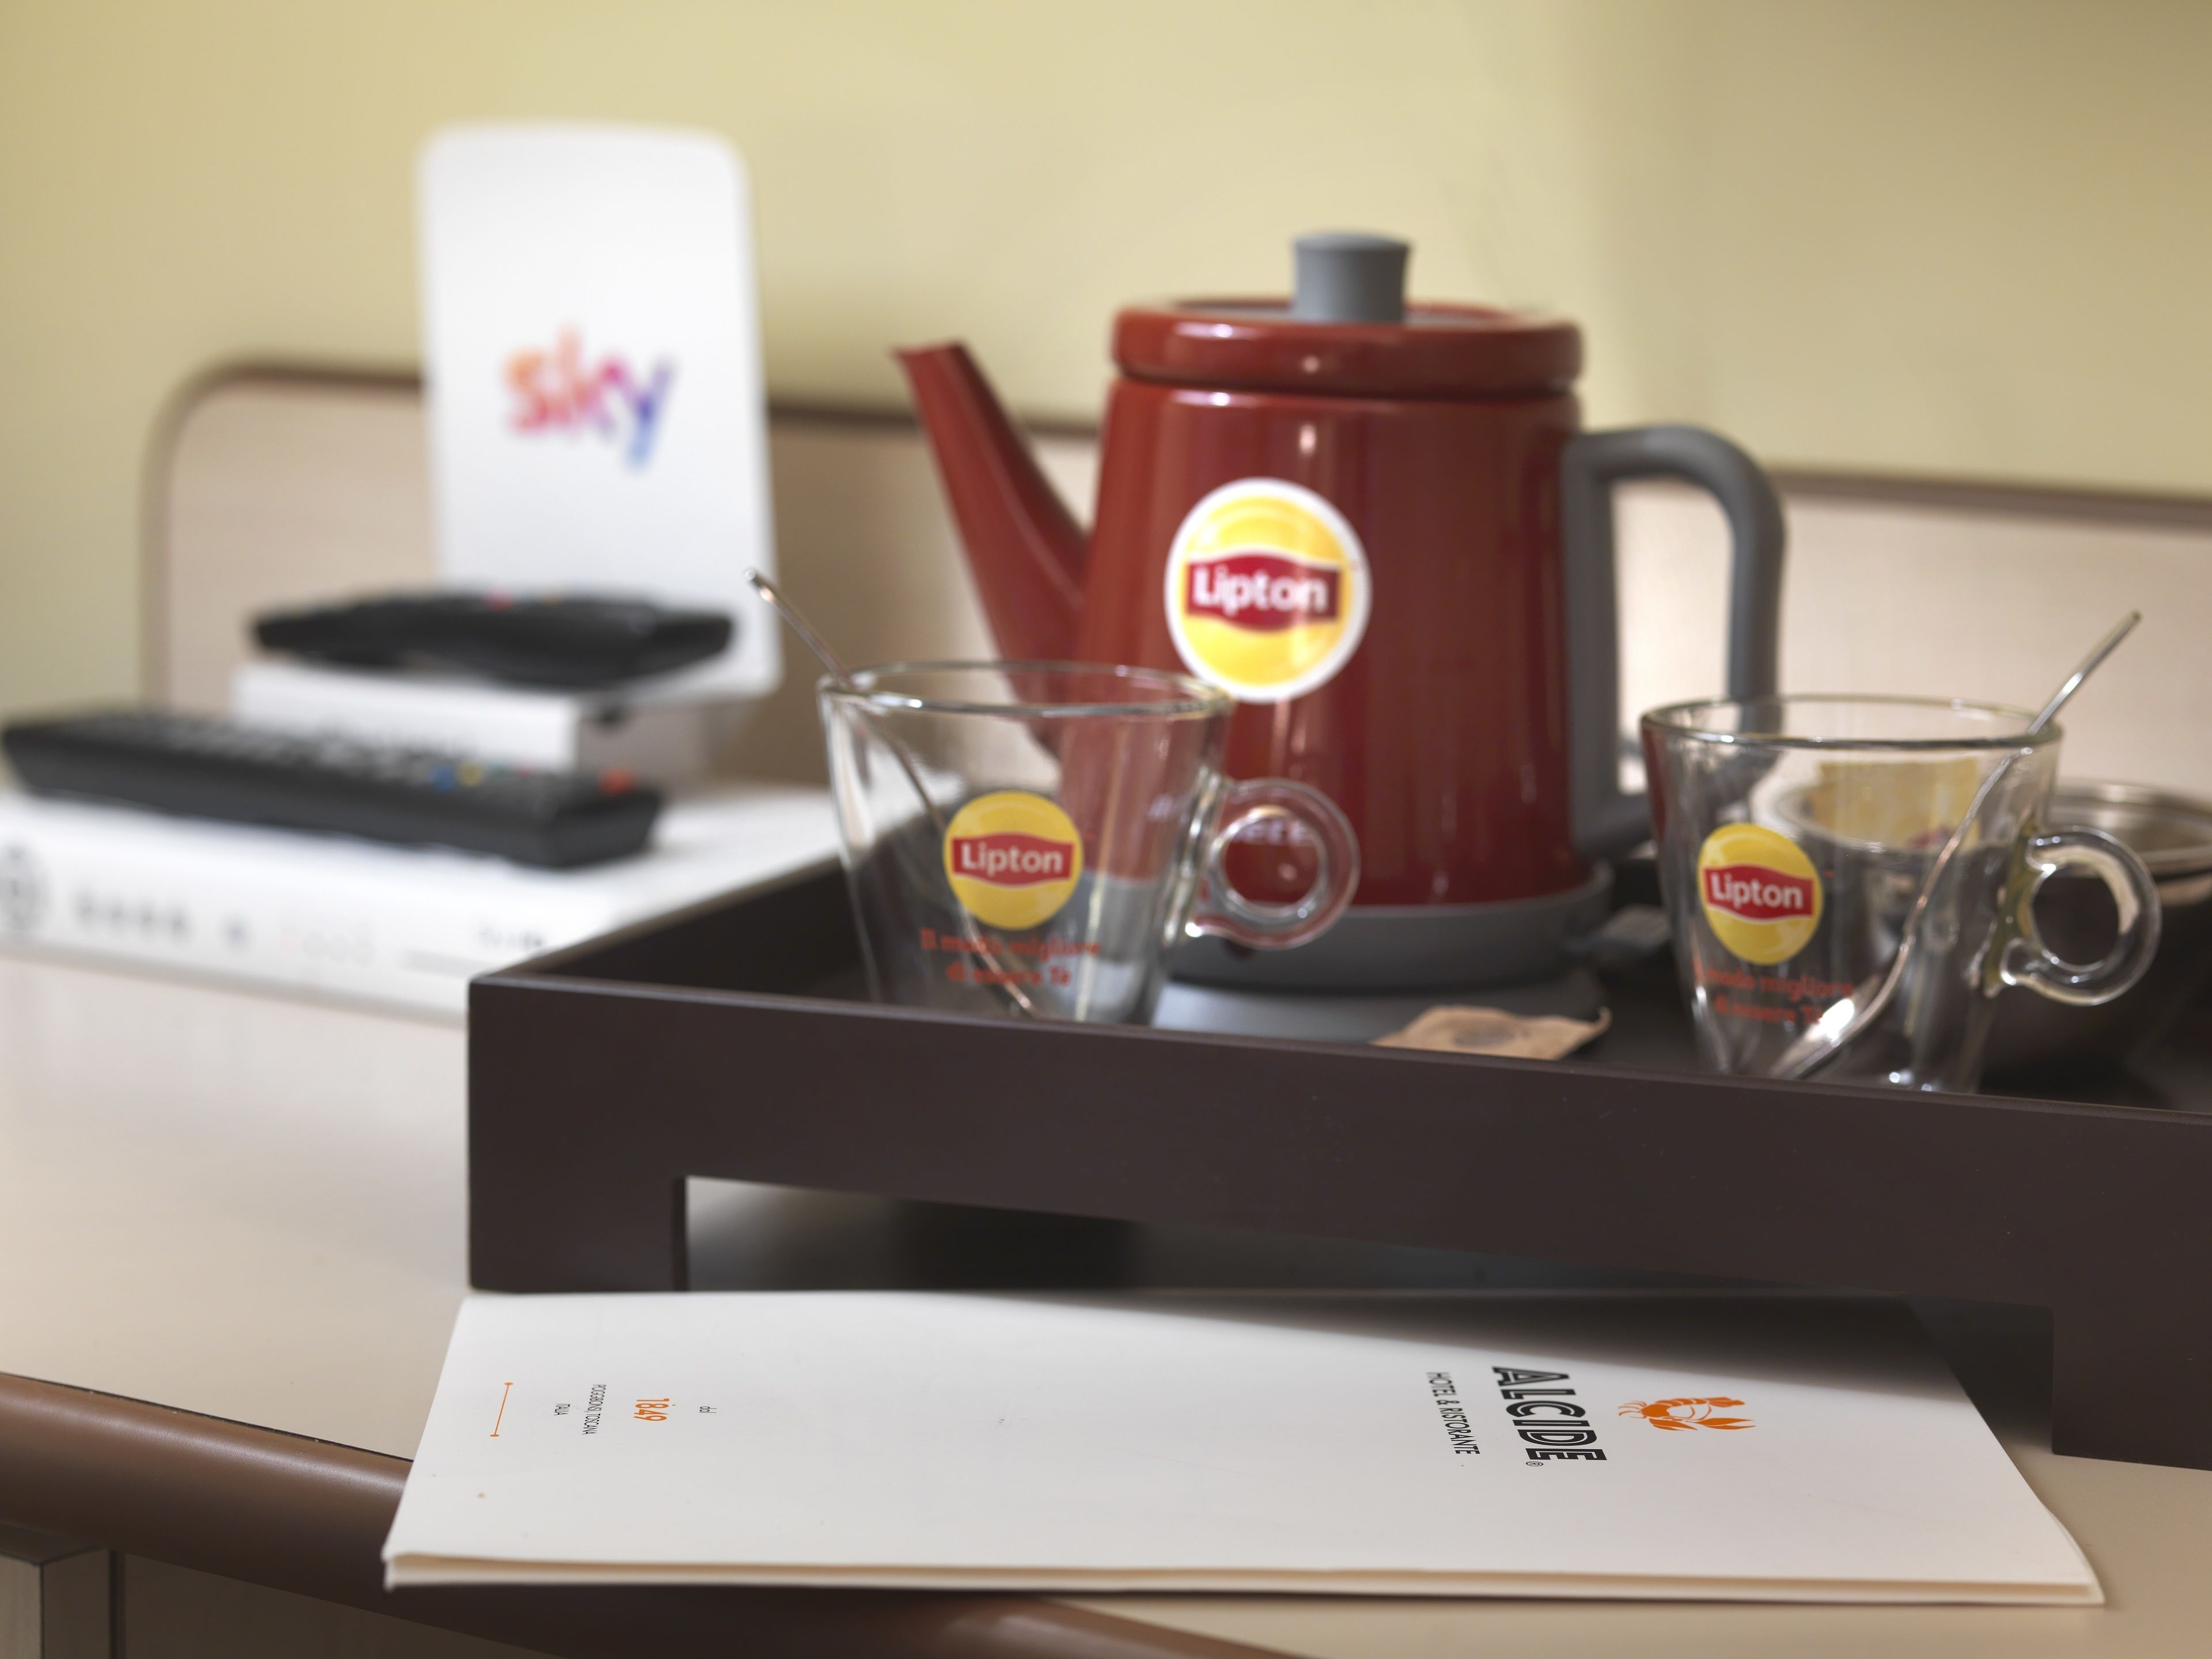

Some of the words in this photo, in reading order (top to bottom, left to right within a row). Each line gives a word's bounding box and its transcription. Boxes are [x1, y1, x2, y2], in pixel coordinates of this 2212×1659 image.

[502, 324, 679, 469] sky
[1191, 566, 1330, 616] Lipton
[961, 842, 1064, 877] Lipton
[1710, 873, 1804, 909] Lipton
[1426, 1372, 1457, 1396] HOTEL
[554, 1403, 571, 1416] ITALIA
[582, 1413, 601, 1435] TOSCANA
[632, 1397, 670, 1422] 1849
[699, 1406, 718, 1414] dal
[1439, 1407, 1480, 1455] RISTORANTE
